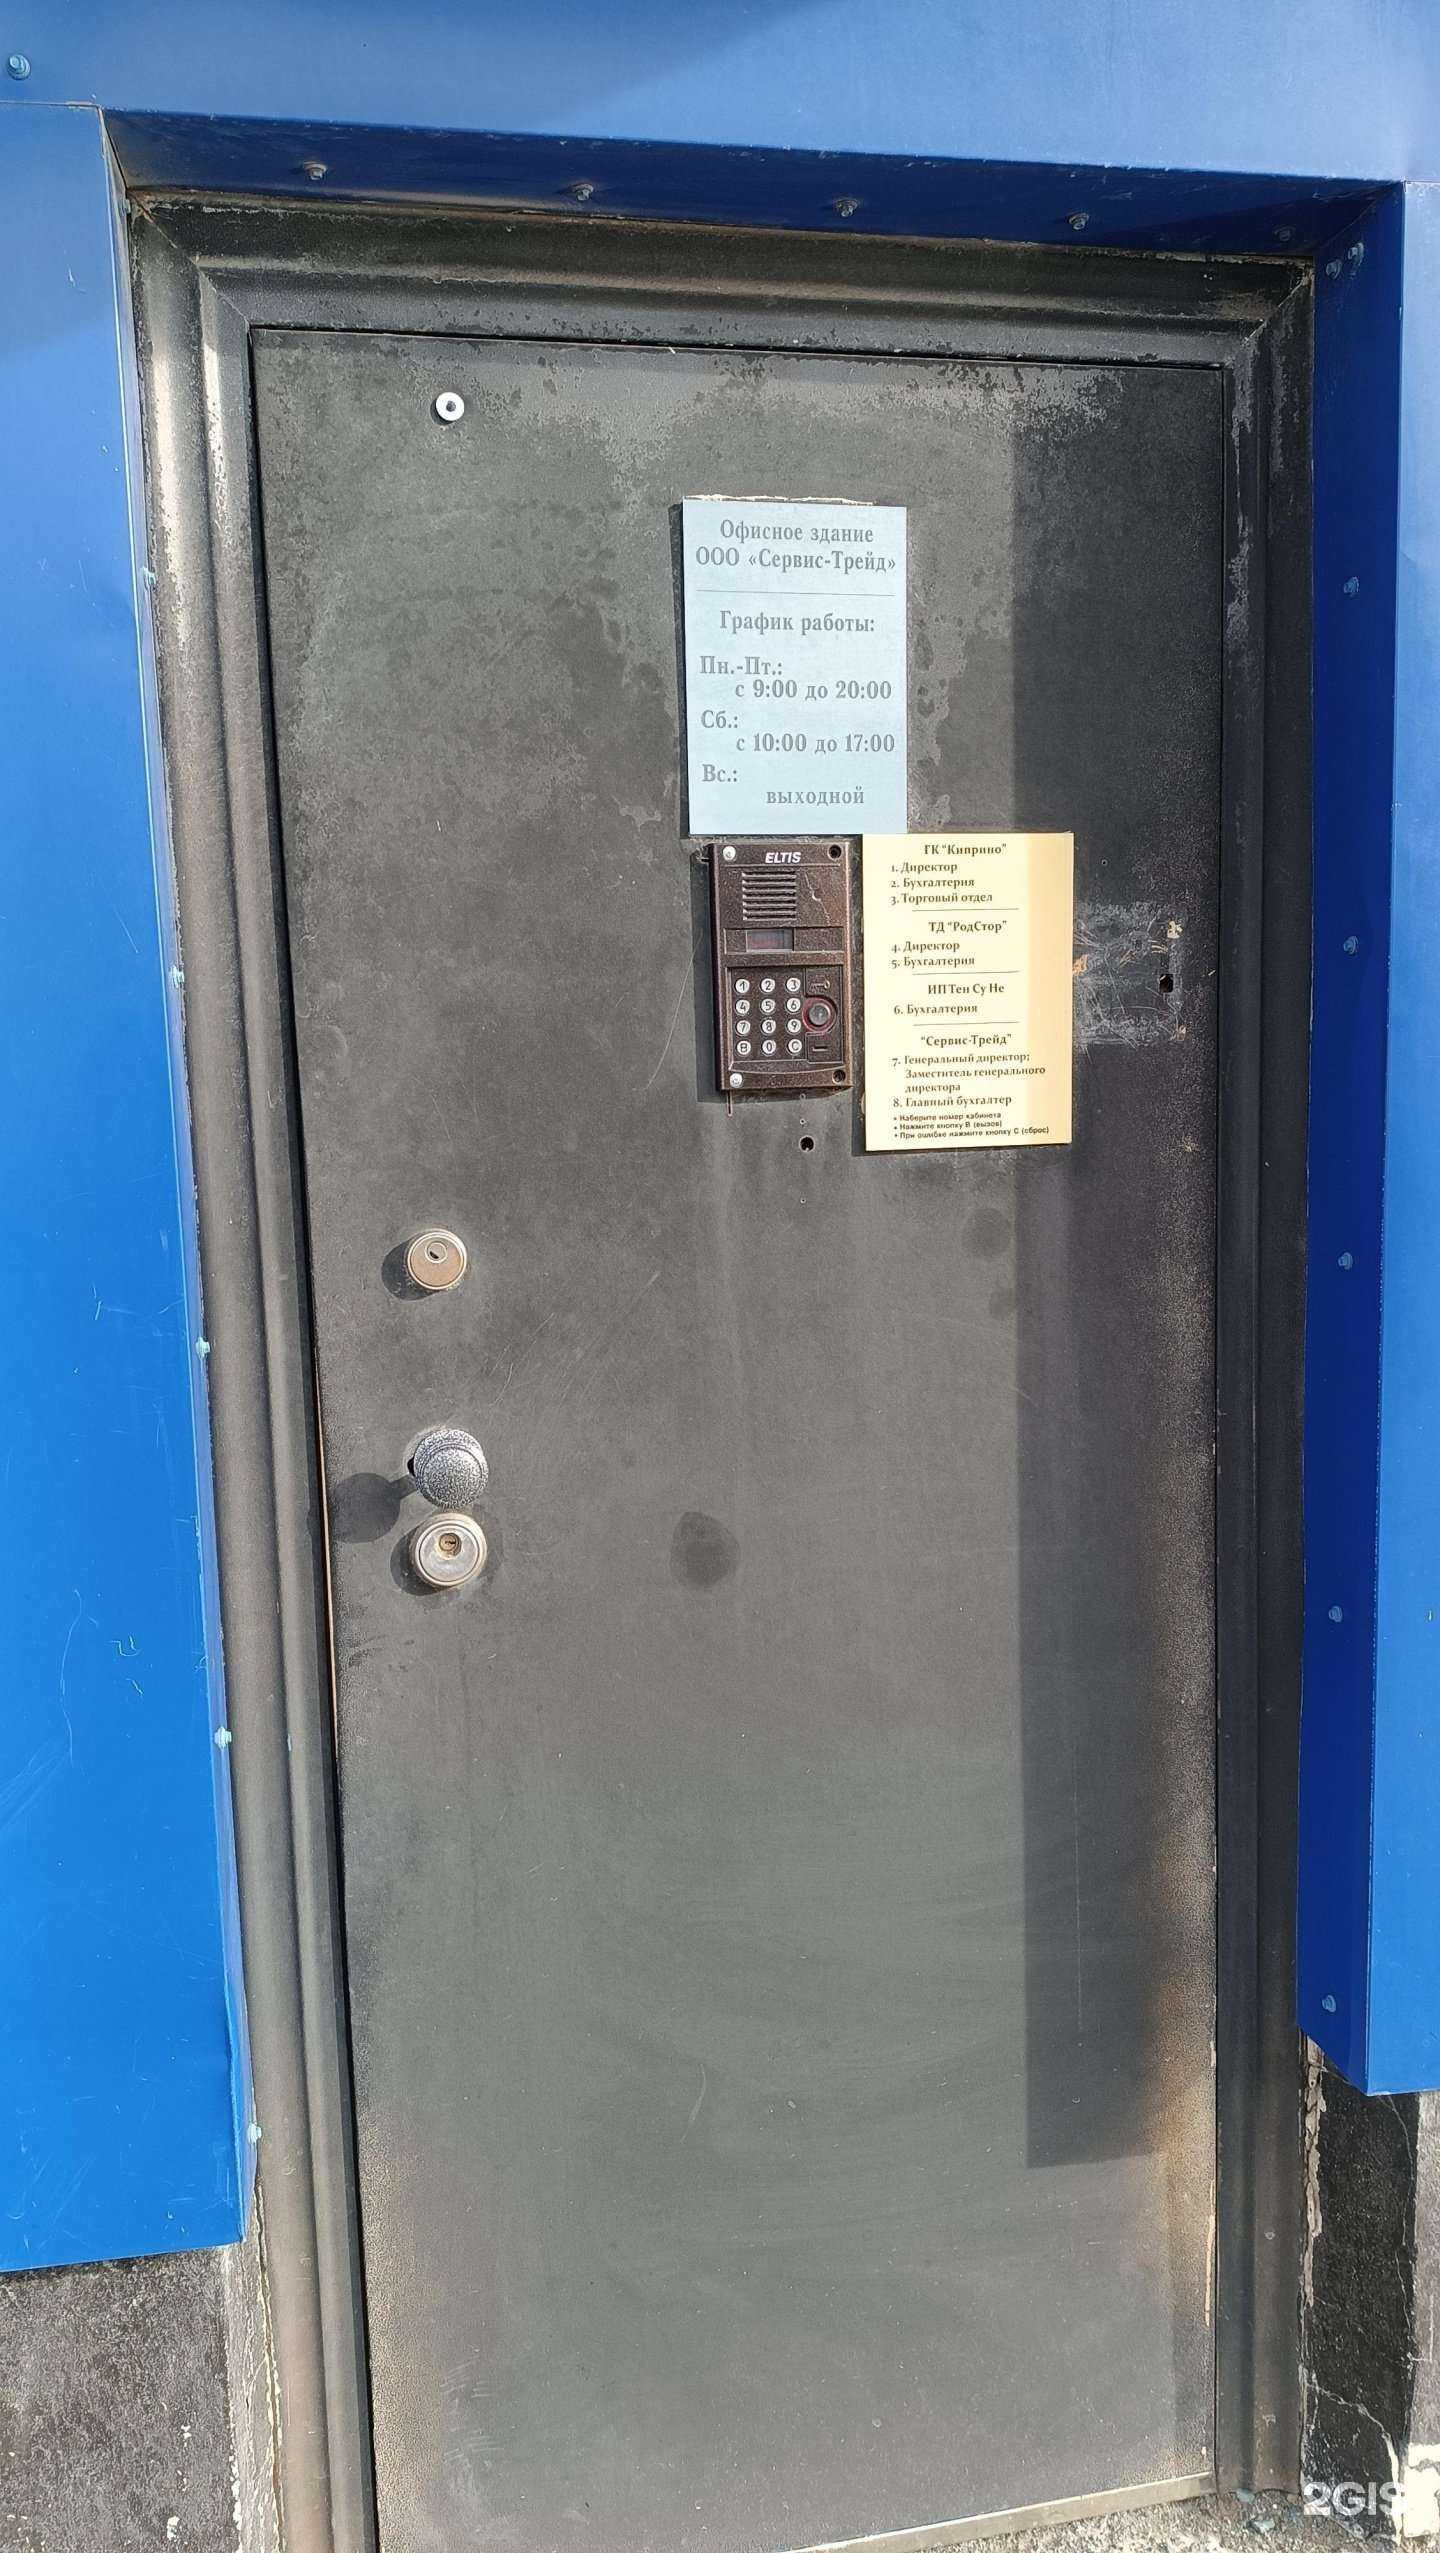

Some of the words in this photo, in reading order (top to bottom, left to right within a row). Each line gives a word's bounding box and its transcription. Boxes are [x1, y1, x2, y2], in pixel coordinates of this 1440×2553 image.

[720, 519, 803, 543] Офисное
[810, 525, 874, 543] здание
[696, 546, 740, 566] ООО
[748, 549, 895, 574] «Сервис-Трейд»
[720, 610, 793, 635] График
[801, 612, 875, 635] работы:
[700, 656, 782, 675] Пн.-Пт.:
[735, 684, 744, 697] с
[753, 680, 797, 698] 9:00
[805, 685, 828, 700] до
[835, 680, 892, 699] 20:00
[701, 710, 738, 729] Сб.:
[736, 738, 745, 751] с
[753, 733, 806, 752] 10:00
[815, 739, 837, 754] до
[845, 734, 895, 752] 17:00
[702, 764, 738, 782] Вс.:
[766, 786, 864, 806] выходной
[924, 844, 939, 855] ГК
[765, 852, 801, 863] ELTIS
[901, 862, 958, 873] Директор
[903, 878, 975, 889] Бухгалтерия
[891, 895, 899, 905] 3.
[901, 892, 958, 904] Торговый
[961, 893, 993, 903] отдел
[928, 921, 944, 933] ТД
[891, 944, 900, 953] 4.
[903, 941, 960, 952] Директор
[891, 960, 900, 969] 5.
[904, 957, 975, 967] Бухгалтерия
[740, 982, 746, 991] 1
[765, 981, 772, 990] 2
[790, 980, 796, 989] 3
[972, 984, 985, 995] Су
[989, 983, 1005, 993] Не
[740, 1002, 746, 1011] 4
[765, 1002, 771, 1010] 5
[790, 1000, 797, 1010] 6
[894, 1005, 903, 1015] 6.
[907, 1004, 978, 1016] Бухгалтерия
[740, 1023, 746, 1032] 7
[766, 1022, 772, 1031] 8
[792, 1021, 797, 1030] 9
[892, 1058, 901, 1067] 7.
[904, 1053, 974, 1066] Генеральный
[976, 1053, 1030, 1064] директор;
[906, 1069, 972, 1078] Заместитель
[974, 1066, 1046, 1077] генерального
[904, 1083, 961, 1093] директора
[893, 1098, 902, 1108] 8.
[906, 1097, 954, 1107] Главный
[957, 1096, 1012, 1108] бухгалтер
[900, 1114, 937, 1122] Наберите
[939, 1113, 964, 1121] номер
[966, 1112, 1001, 1120] кабинета
[917, 1129, 947, 1138] ошибке
[985, 1129, 1011, 1137] кнопку
[1021, 1126, 1049, 1136] (сброс)
